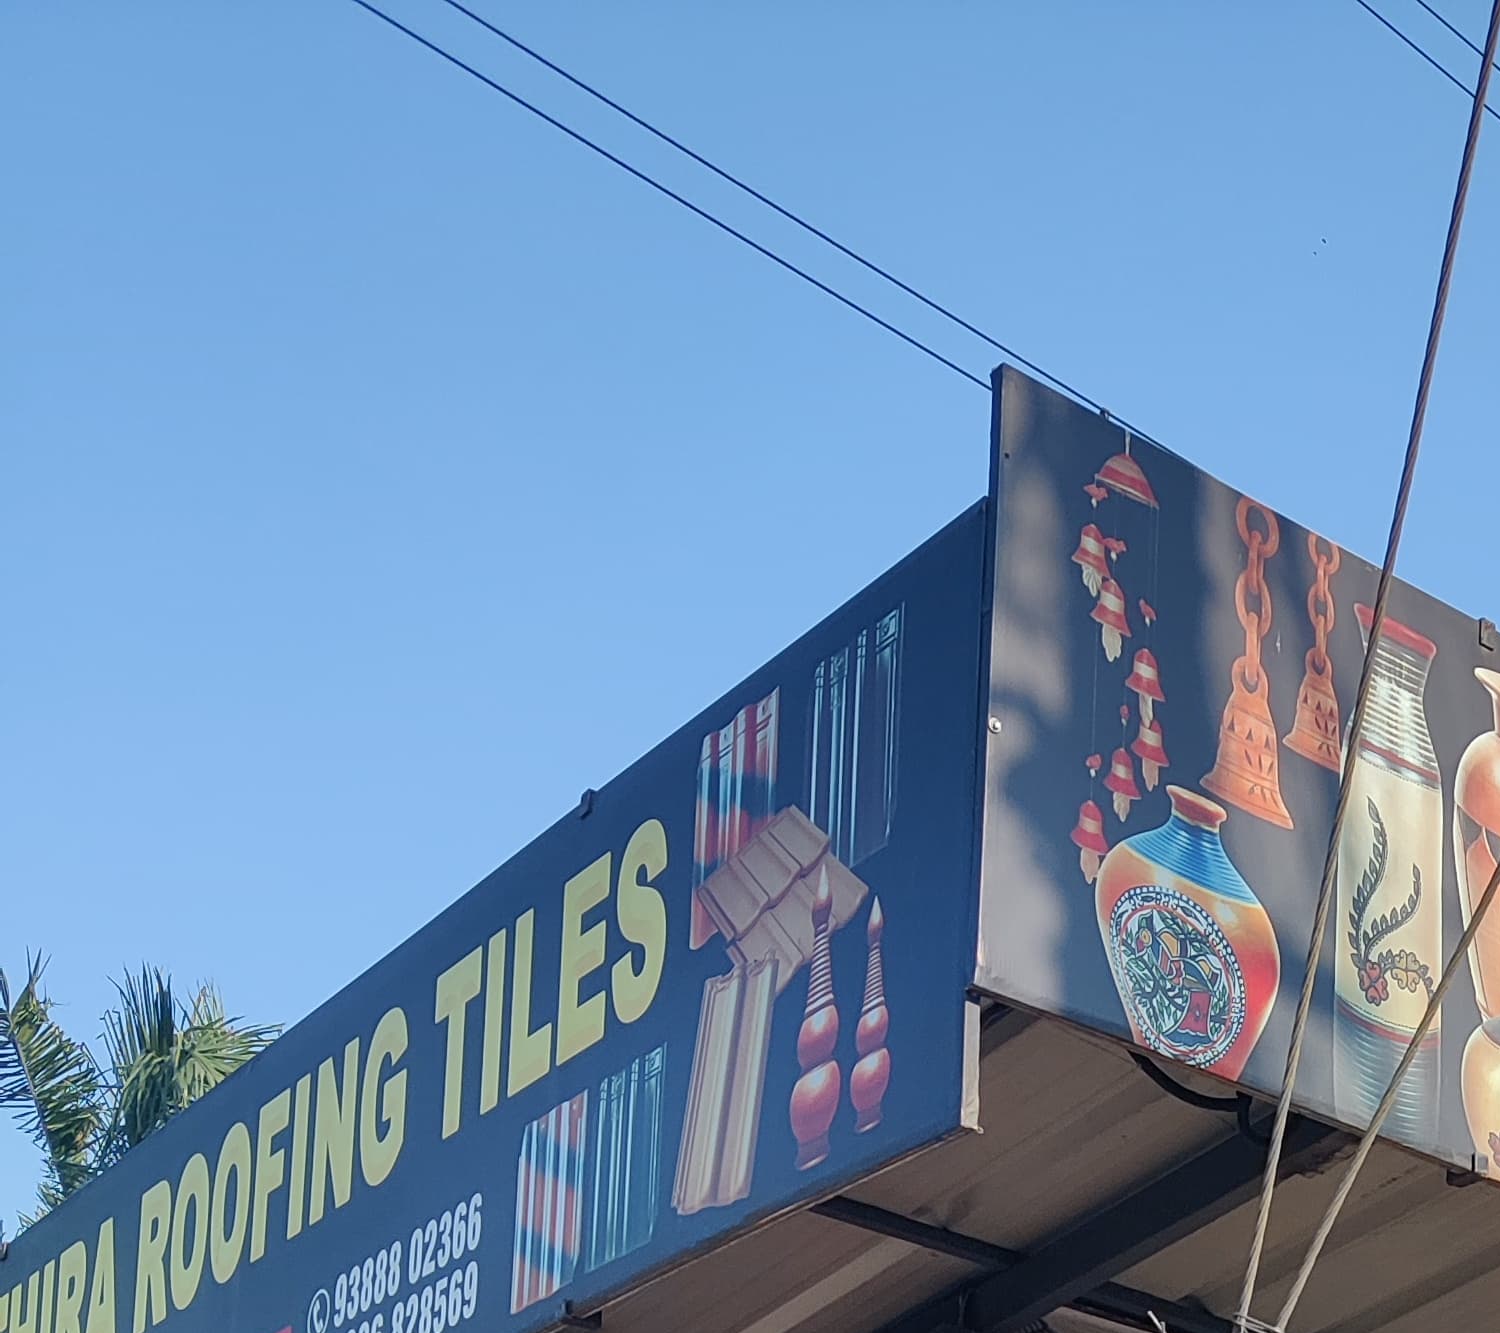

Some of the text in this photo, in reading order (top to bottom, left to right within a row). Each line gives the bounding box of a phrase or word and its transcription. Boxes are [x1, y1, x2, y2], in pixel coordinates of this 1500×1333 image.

[435, 817, 670, 1140] TILES
[333, 1192, 483, 1329] 93888 02366
